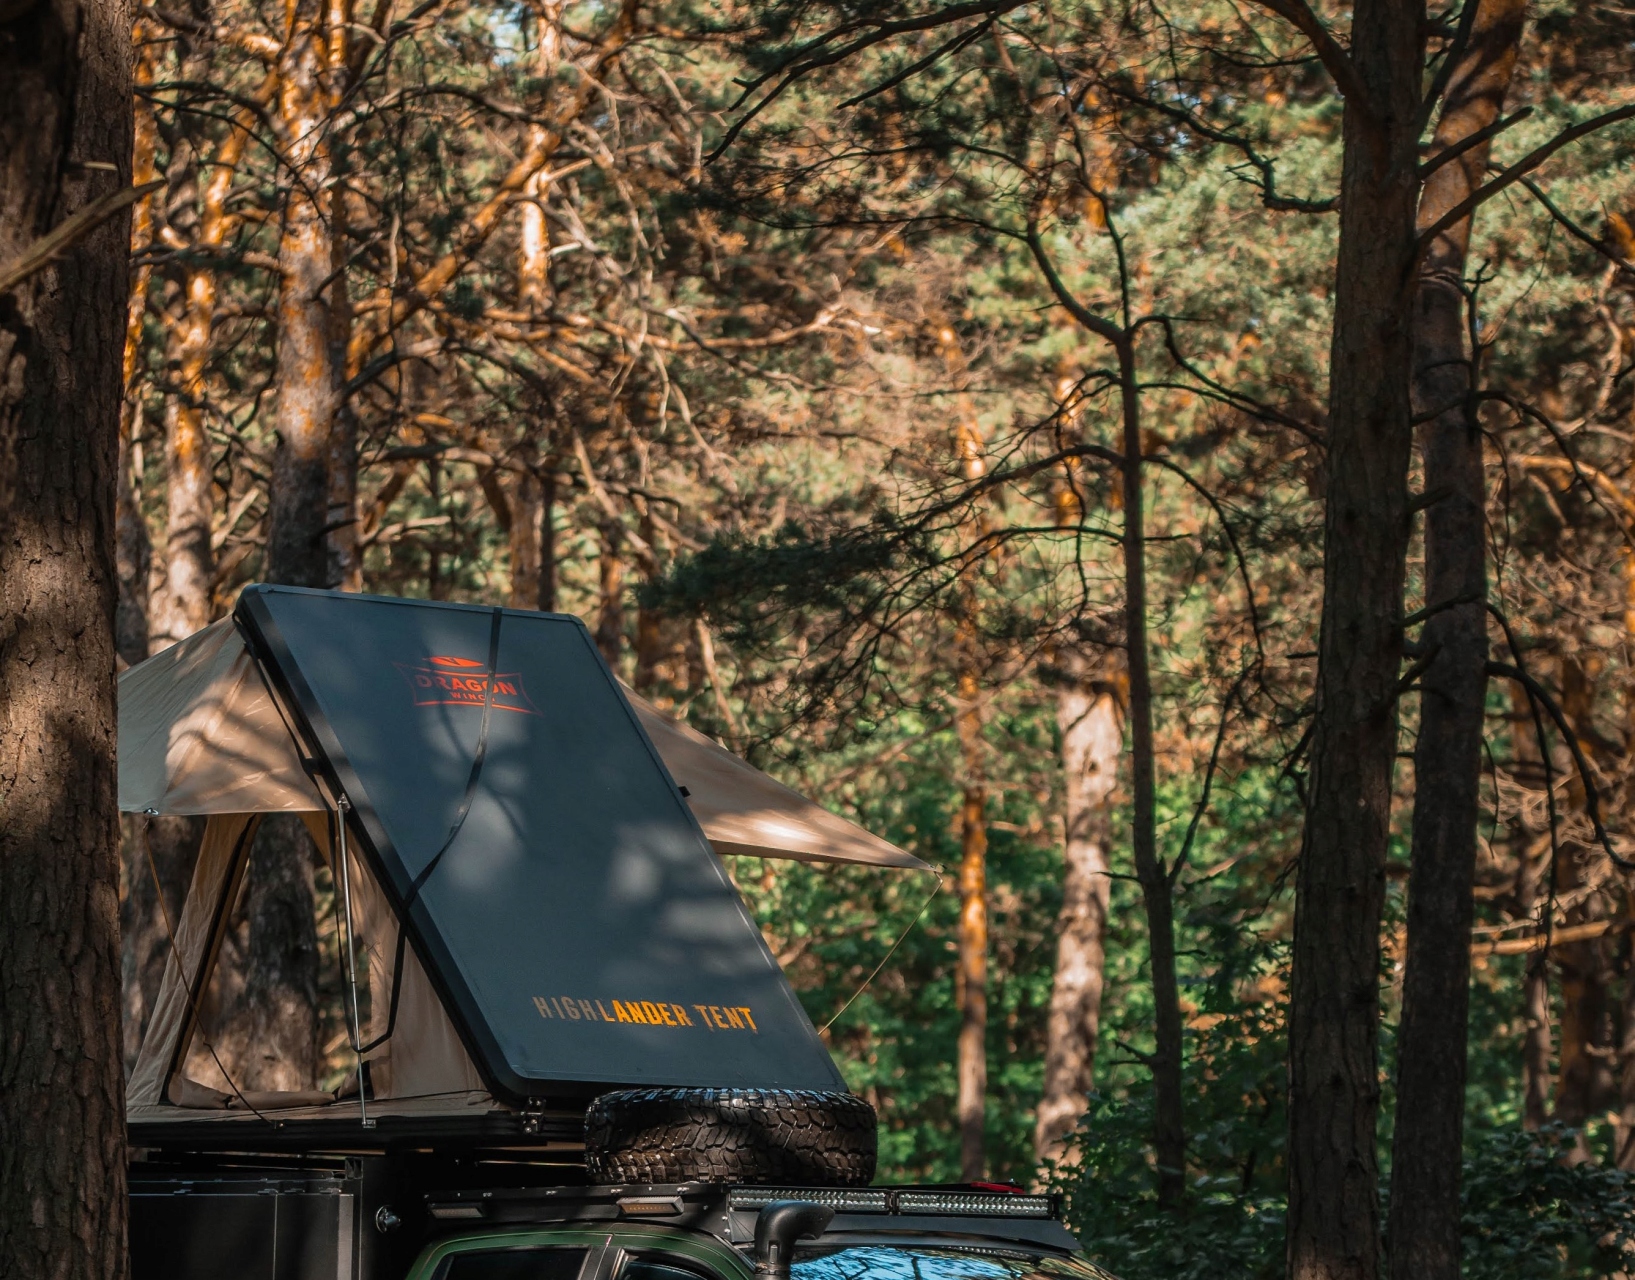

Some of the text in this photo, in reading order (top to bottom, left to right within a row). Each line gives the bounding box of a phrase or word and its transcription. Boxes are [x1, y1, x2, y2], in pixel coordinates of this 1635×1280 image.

[415, 675, 517, 695] DRAGON
[450, 691, 495, 702] WINC
[532, 996, 758, 1034] HIGHLANDER TENT
